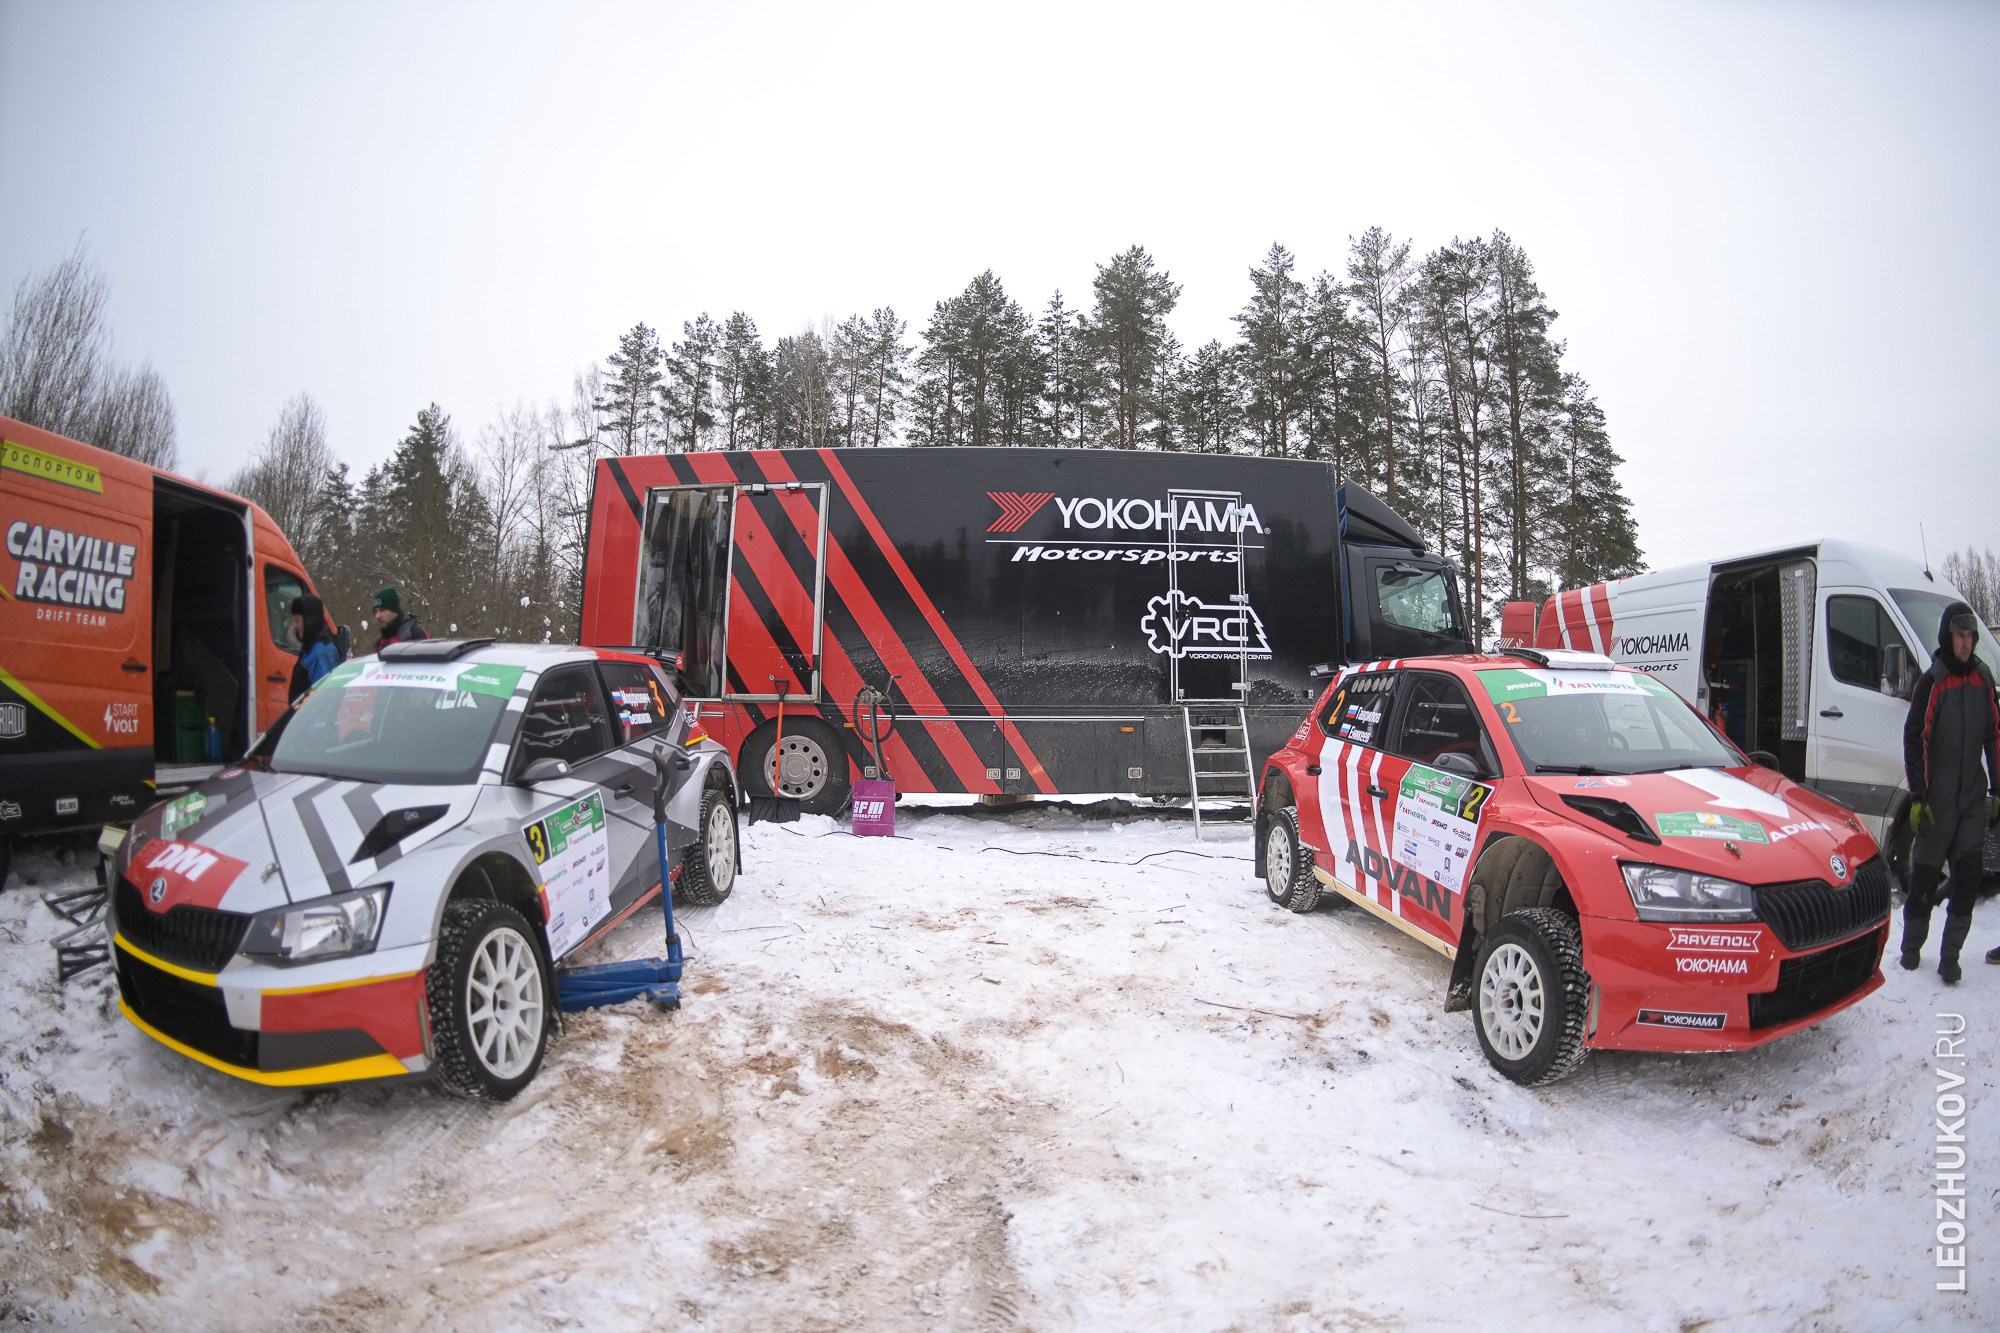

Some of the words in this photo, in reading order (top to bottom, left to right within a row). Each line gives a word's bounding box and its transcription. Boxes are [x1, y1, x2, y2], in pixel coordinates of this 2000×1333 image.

[1054, 497, 1264, 534] YOKOHAMA
[6, 521, 136, 577] CARVILLE
[1011, 546, 1241, 565] Motorsports
[15, 561, 125, 610] RACING
[37, 608, 71, 622] DRIFT
[76, 613, 106, 626] TEAM
[1161, 616, 1248, 642] VRC
[1621, 632, 1689, 656] YOKOHAMA
[374, 672, 446, 682] ТАТНЕФТЬ
[1567, 682, 1636, 690] ТАТНЕФТЬ
[649, 680, 665, 717] 3
[1328, 690, 1346, 724] 2
[112, 703, 138, 716] START
[1500, 702, 1522, 723] 2
[113, 720, 138, 733] VOLT
[1463, 786, 1484, 820] 2
[1402, 807, 1427, 822] ТАТНЕФТЬ
[1770, 821, 1832, 843] ADVAN
[530, 825, 545, 864] 3
[1345, 839, 1451, 921] ADVAN
[1677, 934, 1751, 948] RAVENOL
[1675, 957, 1748, 974] YOKOHAMA
[1663, 1014, 1718, 1028] YOKOHAMA
